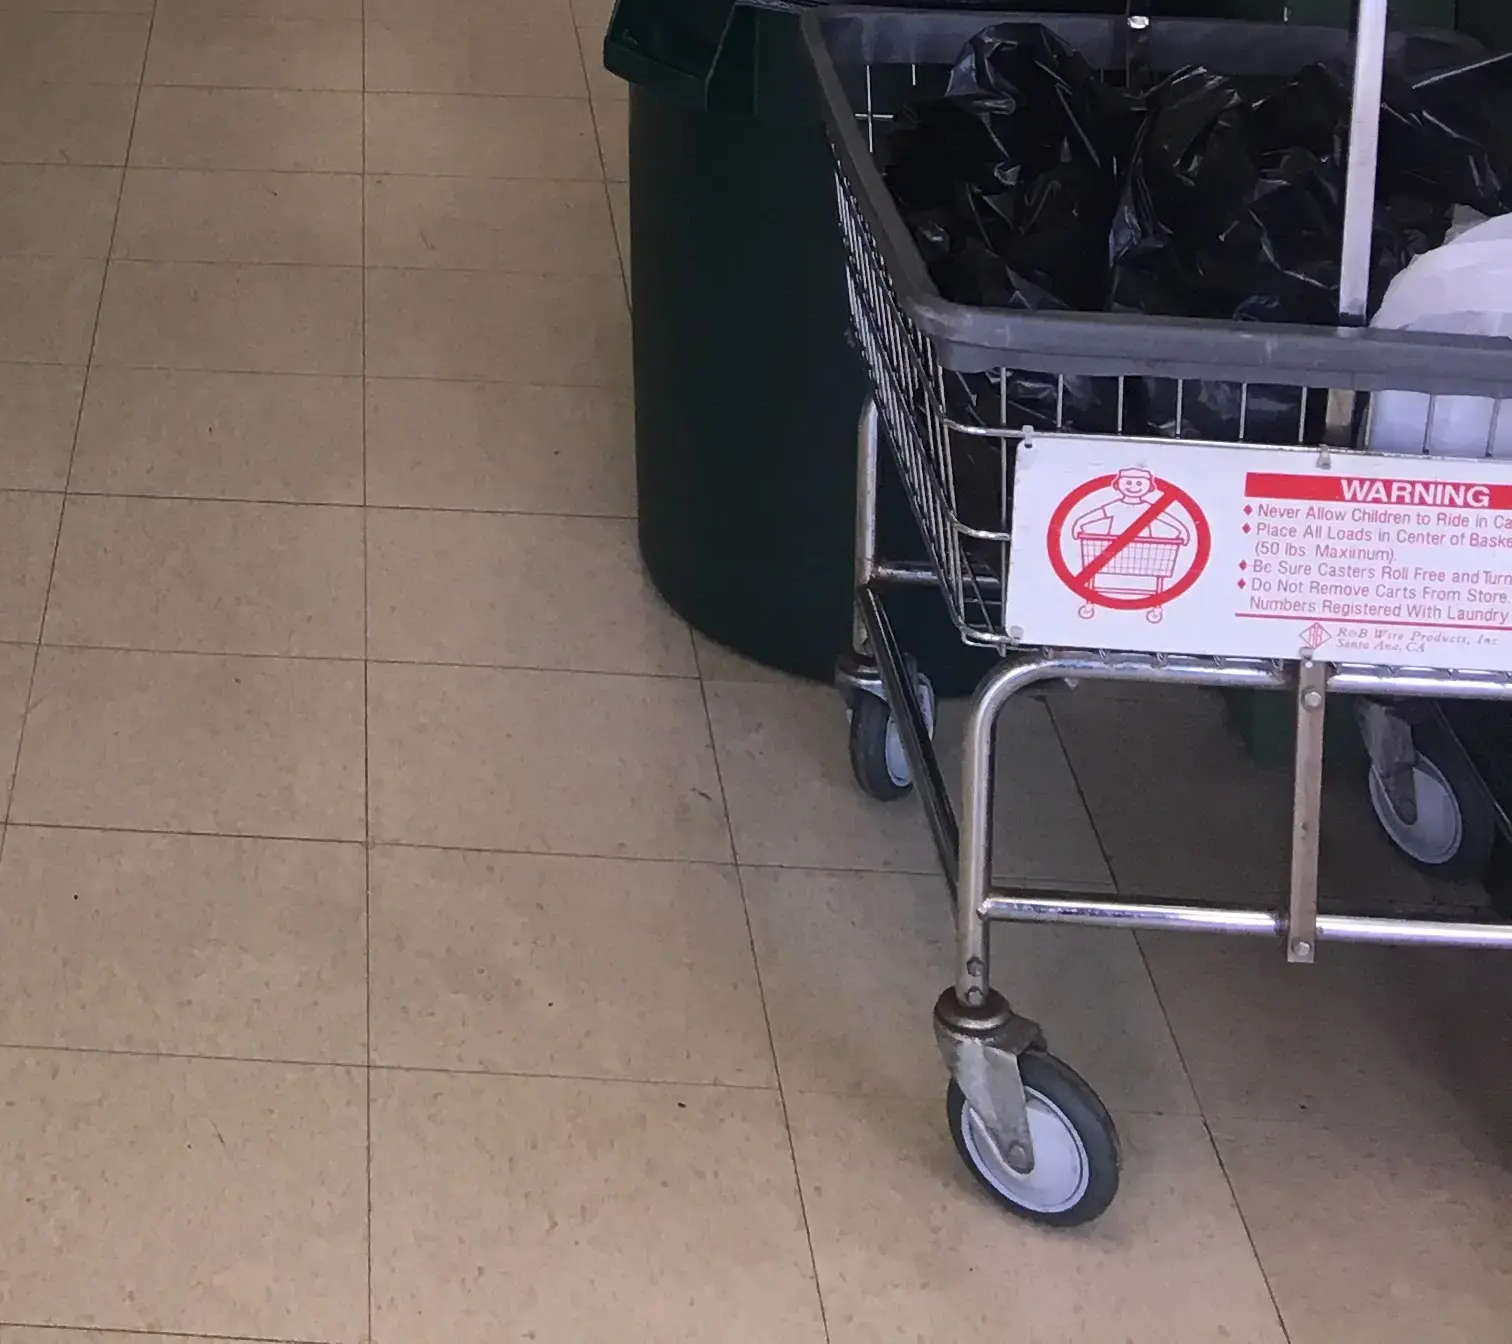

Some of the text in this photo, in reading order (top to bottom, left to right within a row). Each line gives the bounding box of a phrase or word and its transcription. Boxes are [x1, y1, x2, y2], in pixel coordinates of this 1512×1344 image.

[1341, 479, 1490, 507] WARNING
[1257, 504, 1302, 519] Never
[1305, 507, 1346, 522] Allow
[1351, 508, 1411, 524] Children
[1416, 512, 1431, 525] to
[1437, 512, 1470, 527] Ride
[1256, 523, 1297, 538] Place
[1303, 525, 1322, 540] All
[1327, 526, 1372, 541] Loads
[1396, 529, 1445, 545] Center
[1450, 531, 1465, 546] of
[1255, 541, 1279, 557] (50
[1253, 559, 1272, 573] Be
[1278, 561, 1312, 575] Sure
[1318, 563, 1376, 579] Casters
[1381, 566, 1408, 580] Roll
[1414, 568, 1446, 582] Free
[1451, 570, 1479, 584] and
[1251, 577, 1272, 592] Do
[1277, 579, 1304, 593] Not
[1309, 580, 1369, 597] Remove
[1375, 584, 1417, 599] Carts
[1422, 586, 1461, 601] From
[1250, 596, 1509, 625] Numbers Registered With Laundry
[1336, 637, 1370, 650] Santa
[1406, 641, 1426, 653] CA
[1374, 629, 1404, 641] Wire
